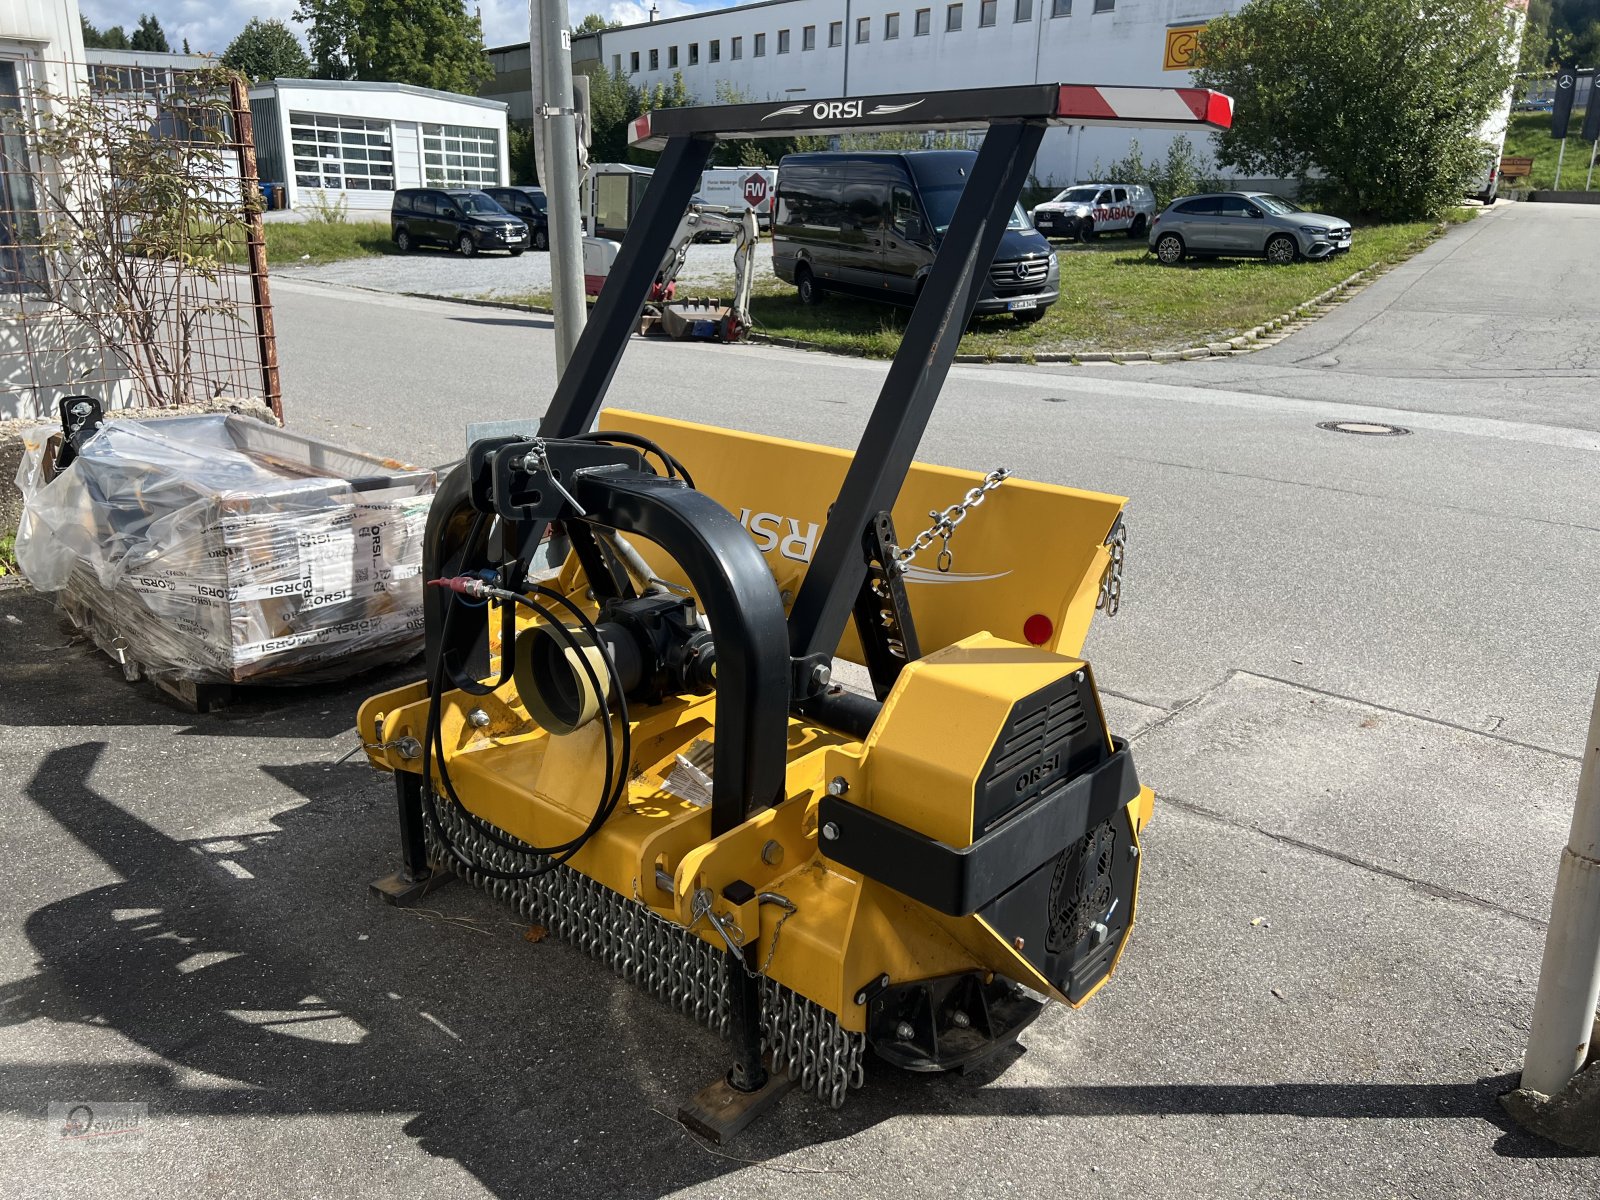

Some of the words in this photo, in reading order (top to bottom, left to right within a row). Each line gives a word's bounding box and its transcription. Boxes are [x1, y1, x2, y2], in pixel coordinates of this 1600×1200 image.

[813, 100, 863, 119] ORSI
[745, 182, 765, 197] FW
[1092, 206, 1135, 222] STRABAG
[371, 525, 382, 558] ORSI
[740, 507, 820, 564] RSI
[140, 578, 168, 590] ORSI
[197, 586, 226, 599] ORSI
[314, 590, 346, 605] ORSI
[1015, 754, 1060, 793] ORSI
